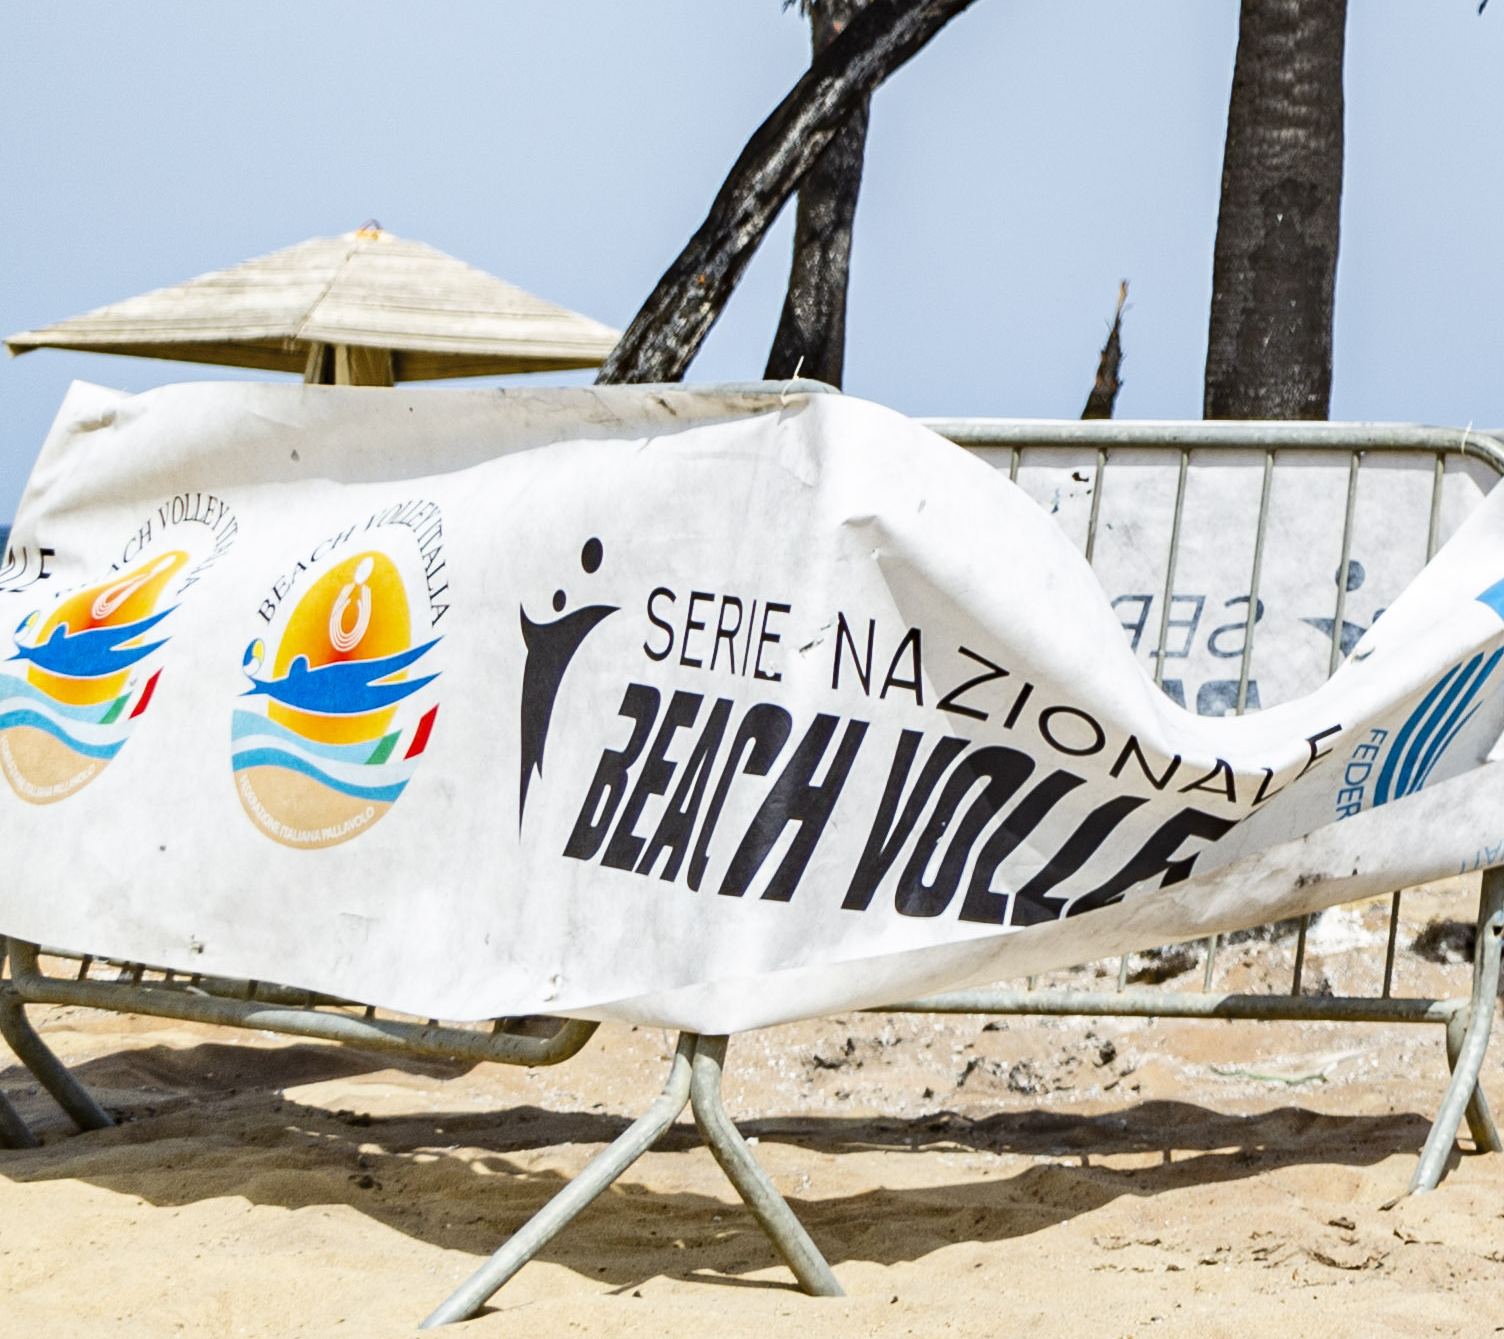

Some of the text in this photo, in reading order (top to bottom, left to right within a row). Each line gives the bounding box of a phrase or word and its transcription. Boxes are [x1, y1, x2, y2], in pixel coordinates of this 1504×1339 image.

[158, 493, 230, 531] VOLLEY
[256, 524, 357, 624] BEACH
[416, 517, 452, 628] ITALIA
[642, 586, 792, 683] SERIE
[561, 681, 871, 904] BEACH
